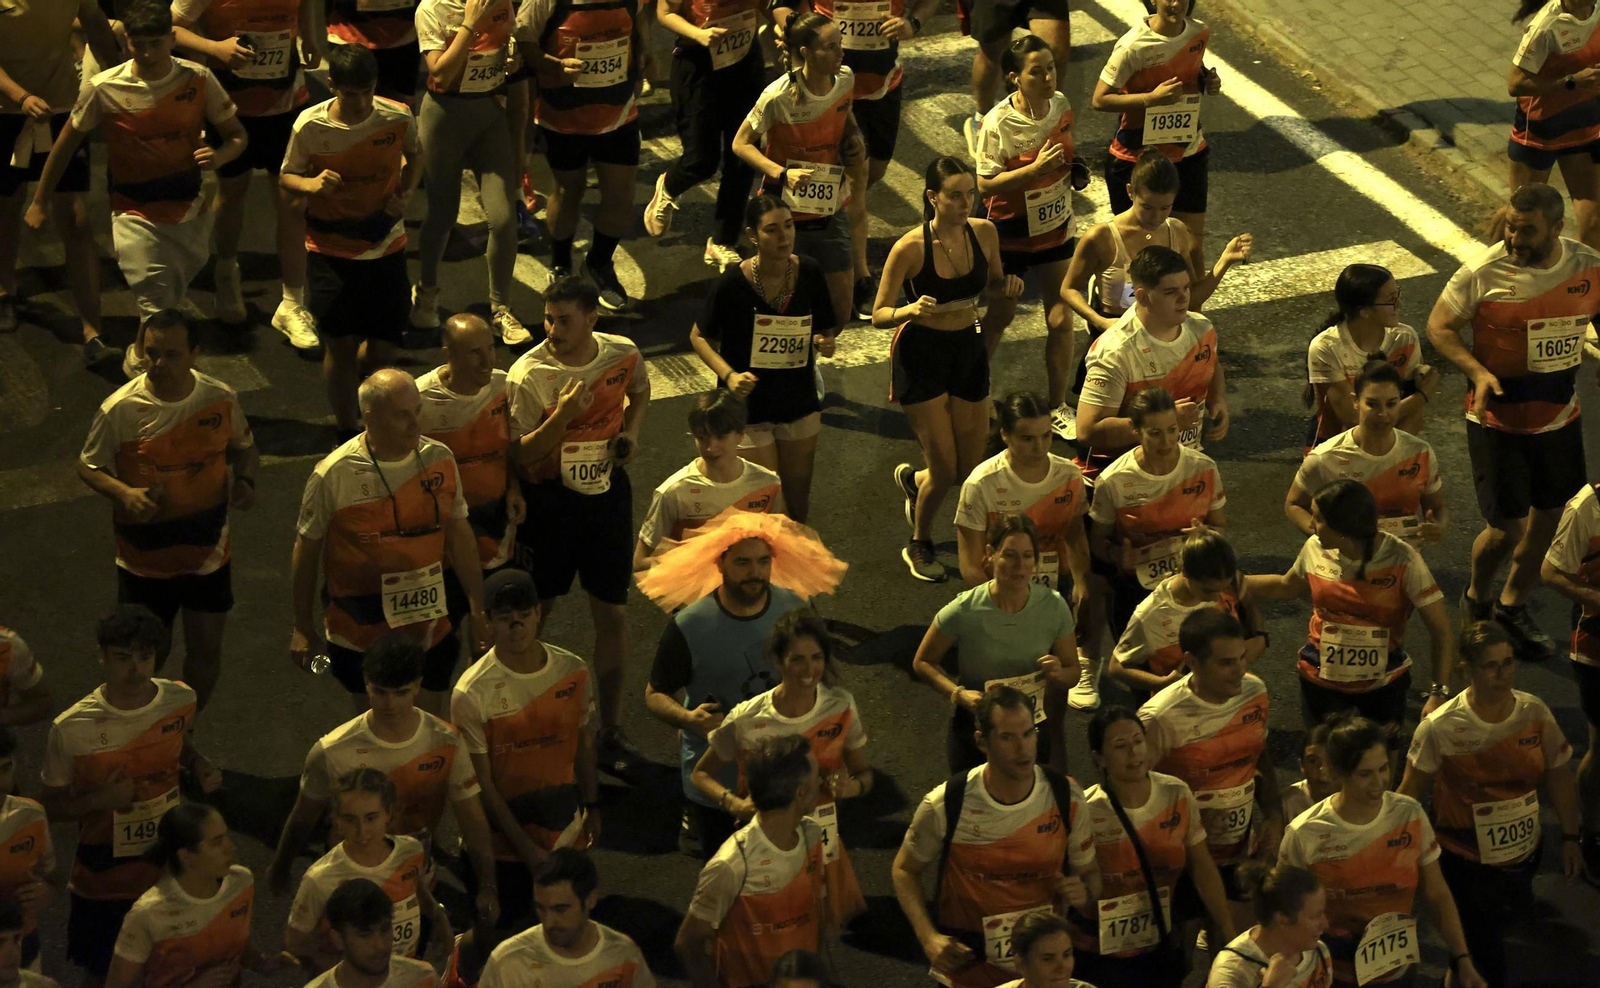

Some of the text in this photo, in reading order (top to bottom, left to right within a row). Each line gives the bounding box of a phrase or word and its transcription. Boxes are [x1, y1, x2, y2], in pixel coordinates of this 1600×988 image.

[840, 21, 884, 36] 21220
[716, 31, 751, 55] 21223
[581, 57, 622, 74] 24354
[1151, 114, 1191, 130] 19382
[792, 183, 833, 200] 19383
[1038, 196, 1066, 220] 8762
[759, 337, 804, 353] 22984
[1536, 337, 1579, 357] 16057
[390, 587, 438, 610] 14480
[1326, 646, 1378, 666] 21290
[1229, 808, 1247, 828] 93
[123, 821, 156, 841] 149
[1487, 817, 1534, 847] 12039
[1361, 930, 1408, 964] 17175
